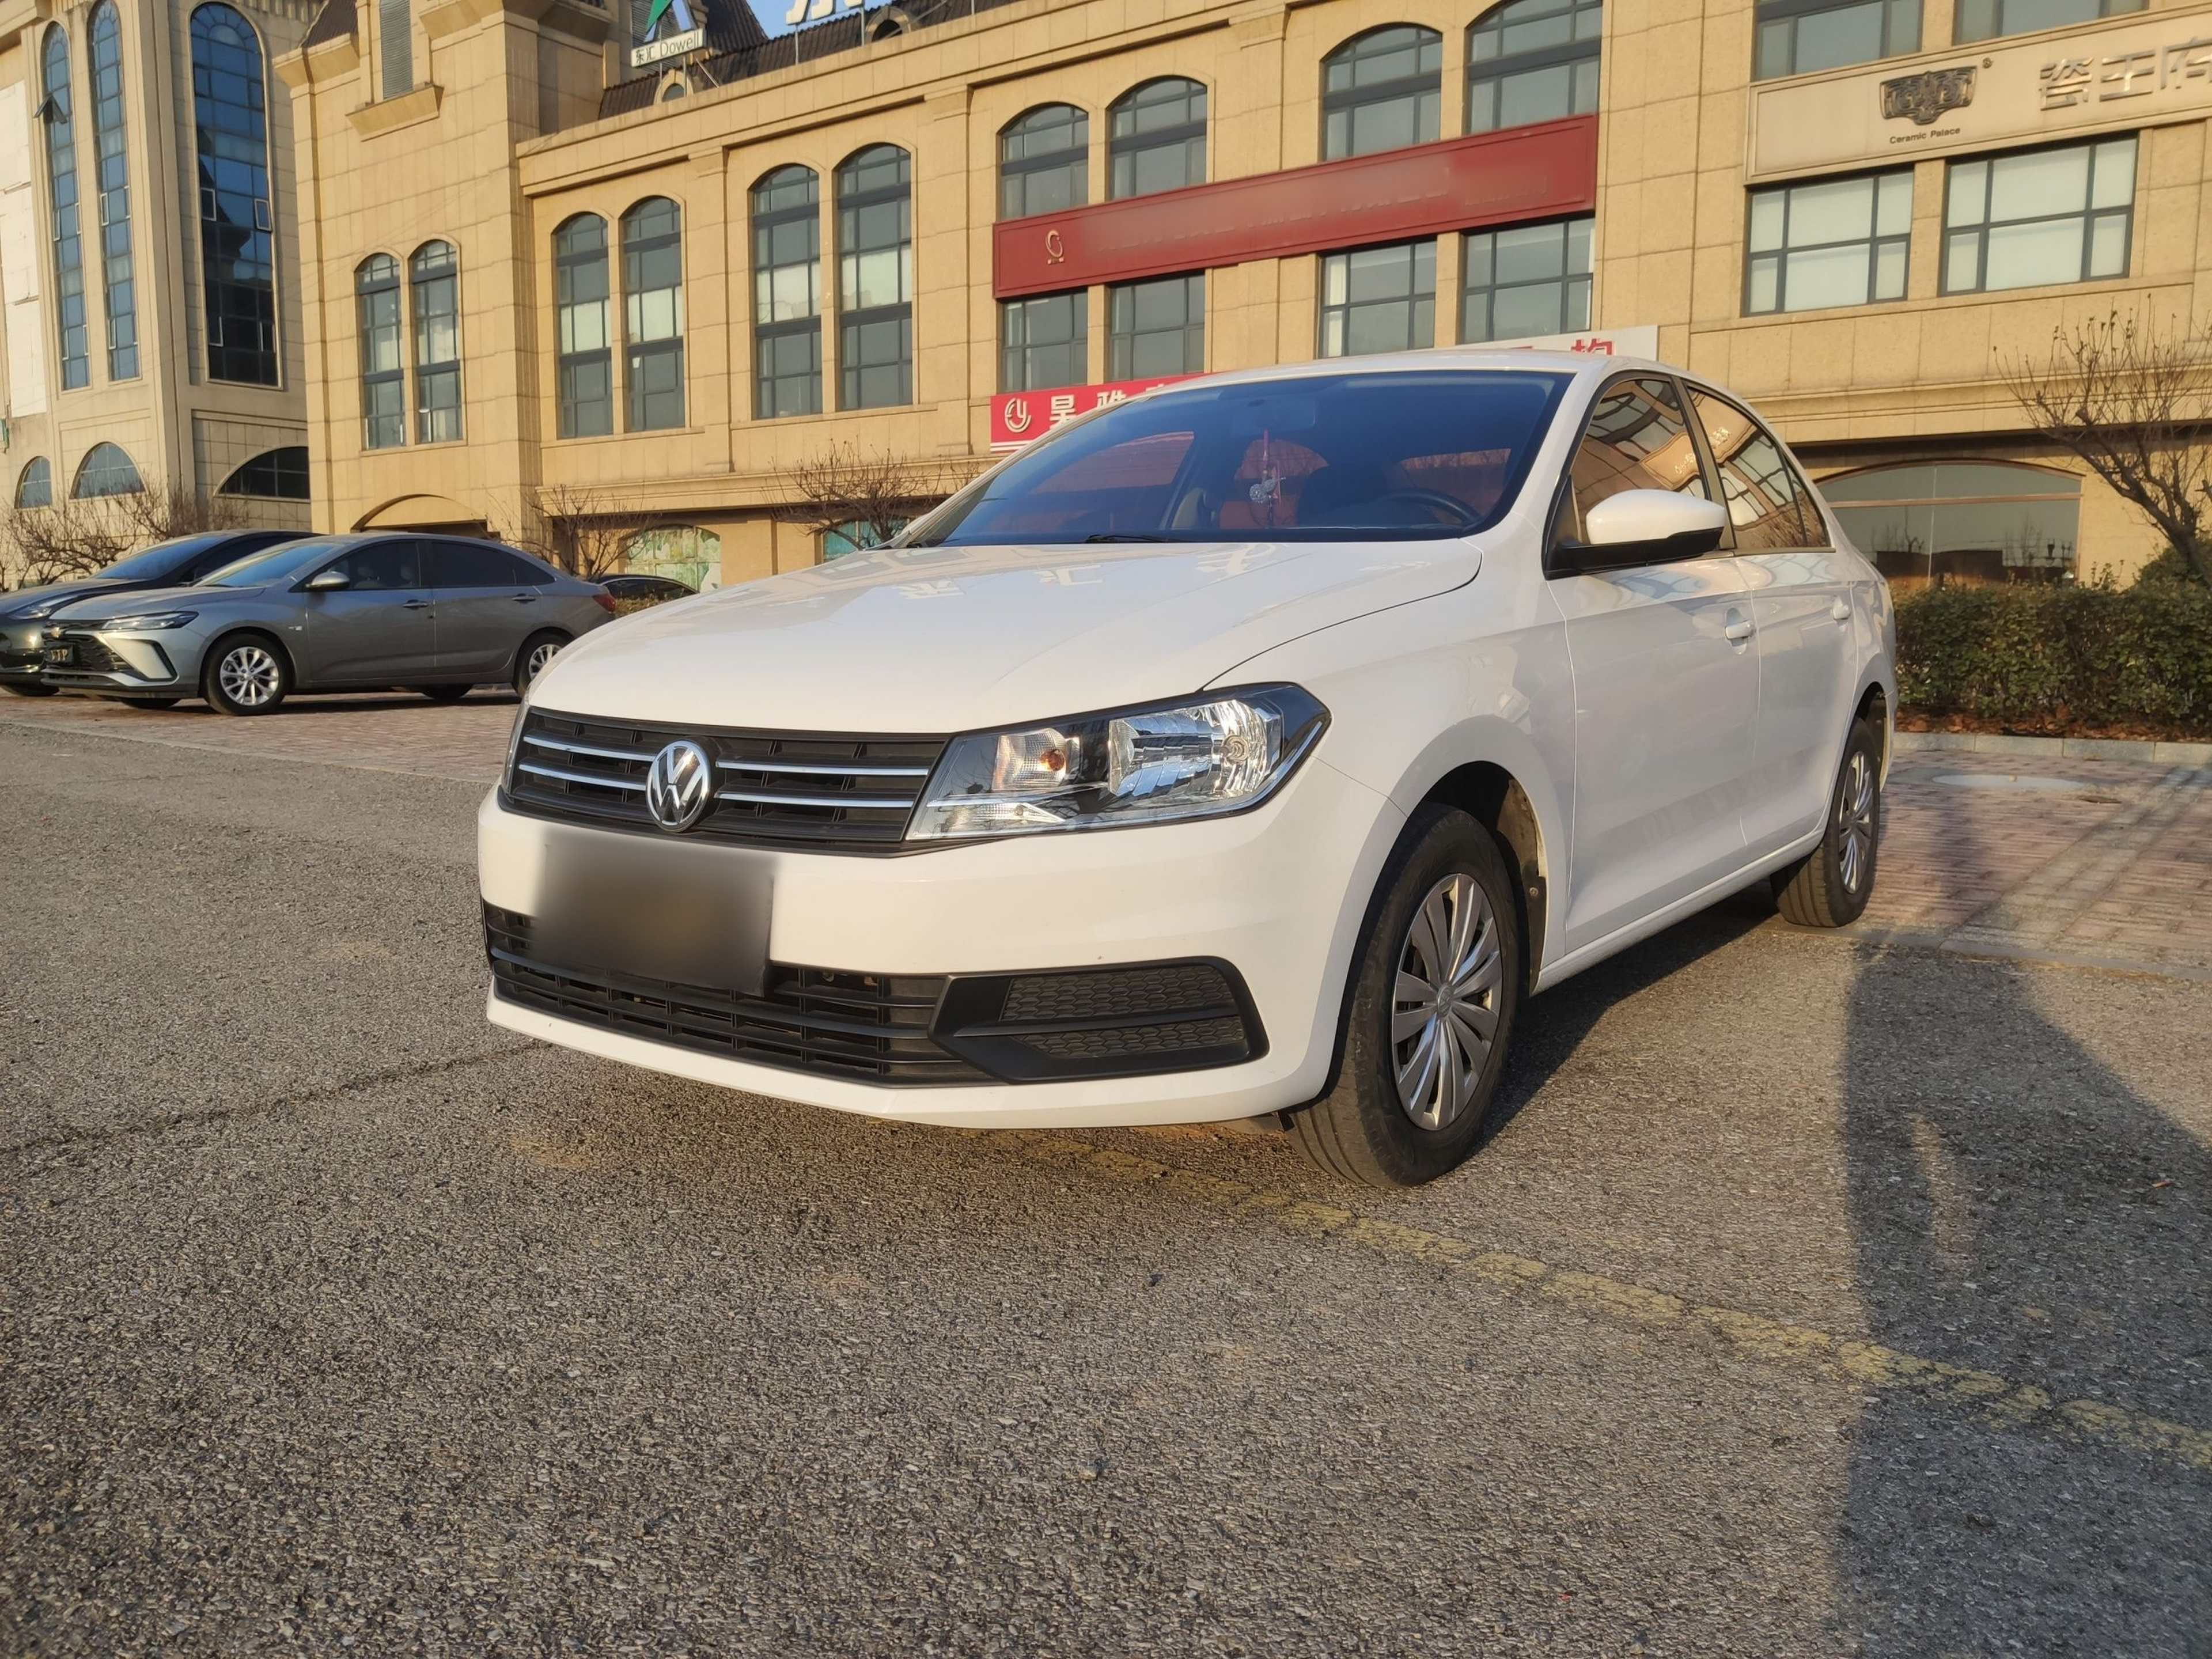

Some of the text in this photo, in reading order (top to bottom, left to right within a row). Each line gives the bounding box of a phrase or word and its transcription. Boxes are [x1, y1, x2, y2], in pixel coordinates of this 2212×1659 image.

[635, 31, 699, 64] 东汇 Dowell
[1889, 127, 1961, 144] Ceramic Palace
